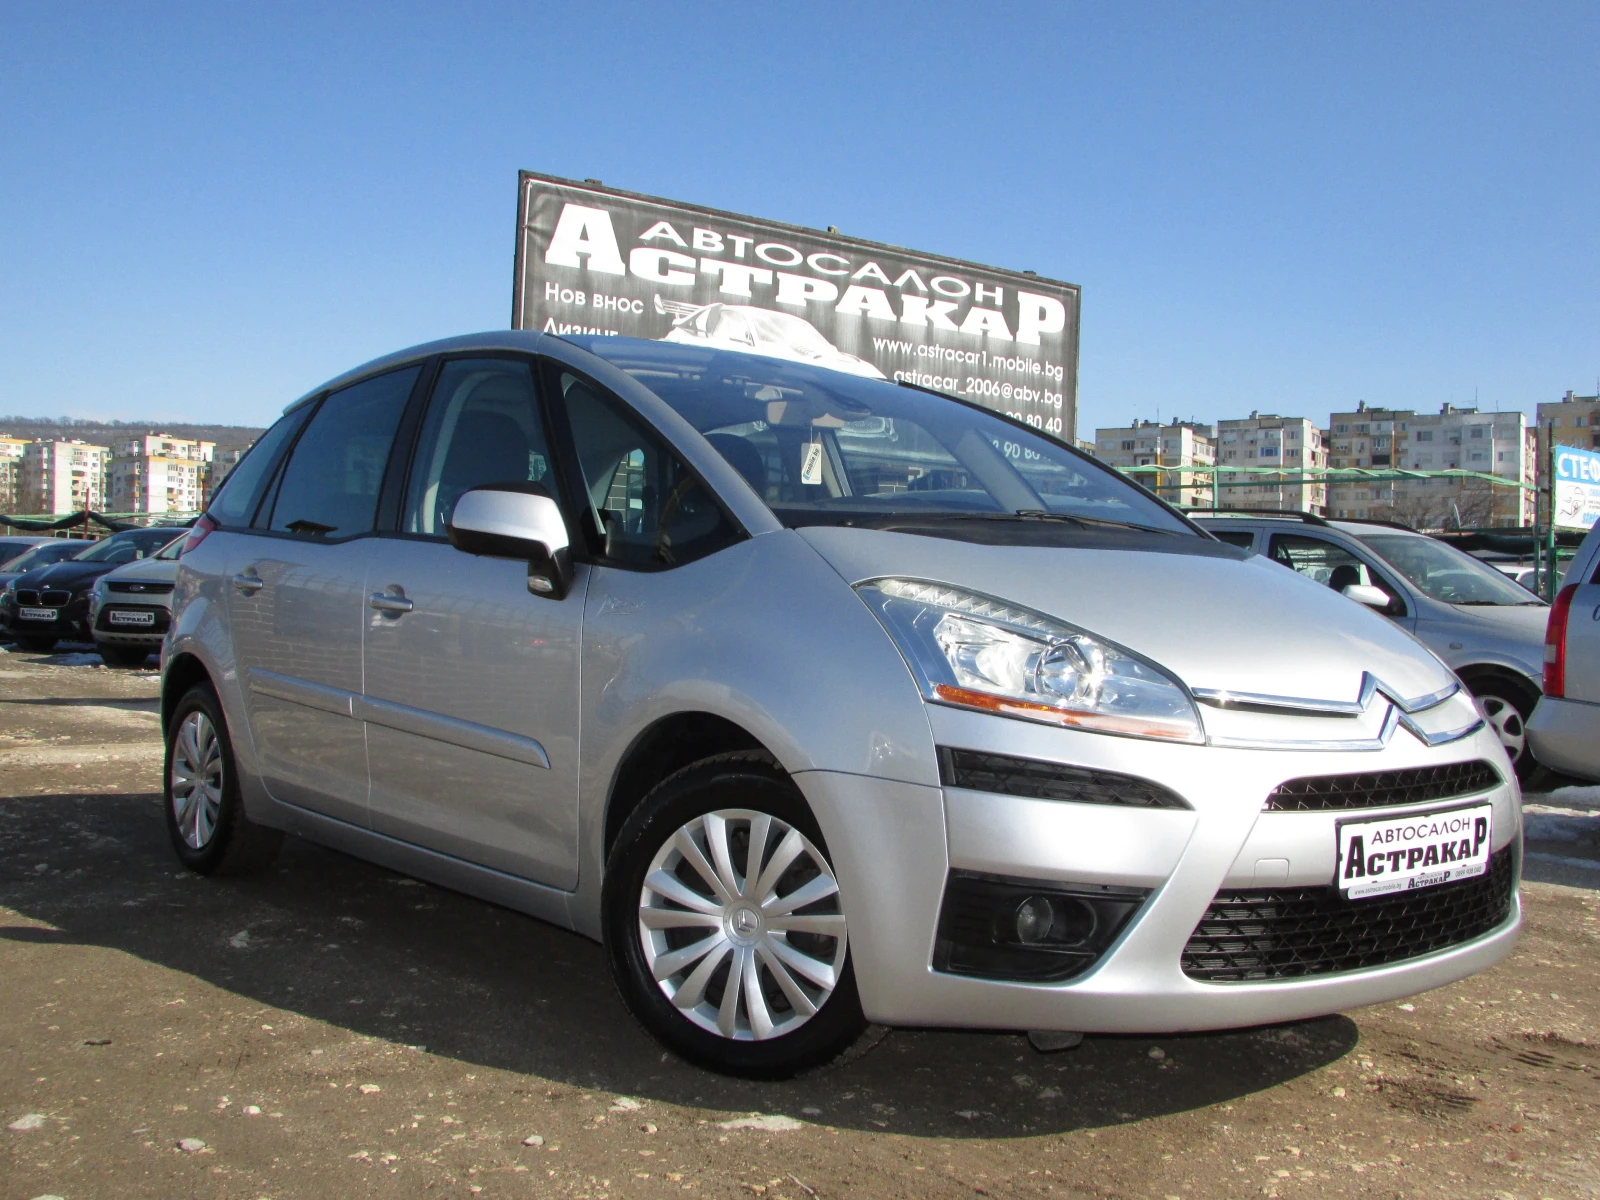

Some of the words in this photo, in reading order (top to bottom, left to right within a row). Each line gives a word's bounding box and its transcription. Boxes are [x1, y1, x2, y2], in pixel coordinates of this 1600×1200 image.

[545, 202, 1066, 346] АСТРАКАР
[639, 221, 1003, 306] АВТОСАЛОН
[545, 281, 586, 306] Нов
[592, 293, 644, 314] внос
[872, 336, 1064, 382] www.astracar1.mobile.bg
[893, 369, 1063, 409] astracar_2006@abv.bg
[1026, 413, 1042, 430] 80
[1045, 416, 1062, 433] 40
[1003, 441, 1021, 459] 90
[1344, 816, 1487, 880] АСТРАКАР
[1371, 816, 1471, 845] АВТОСАЛОН
[1408, 870, 1451, 889] АСТРАКАР
